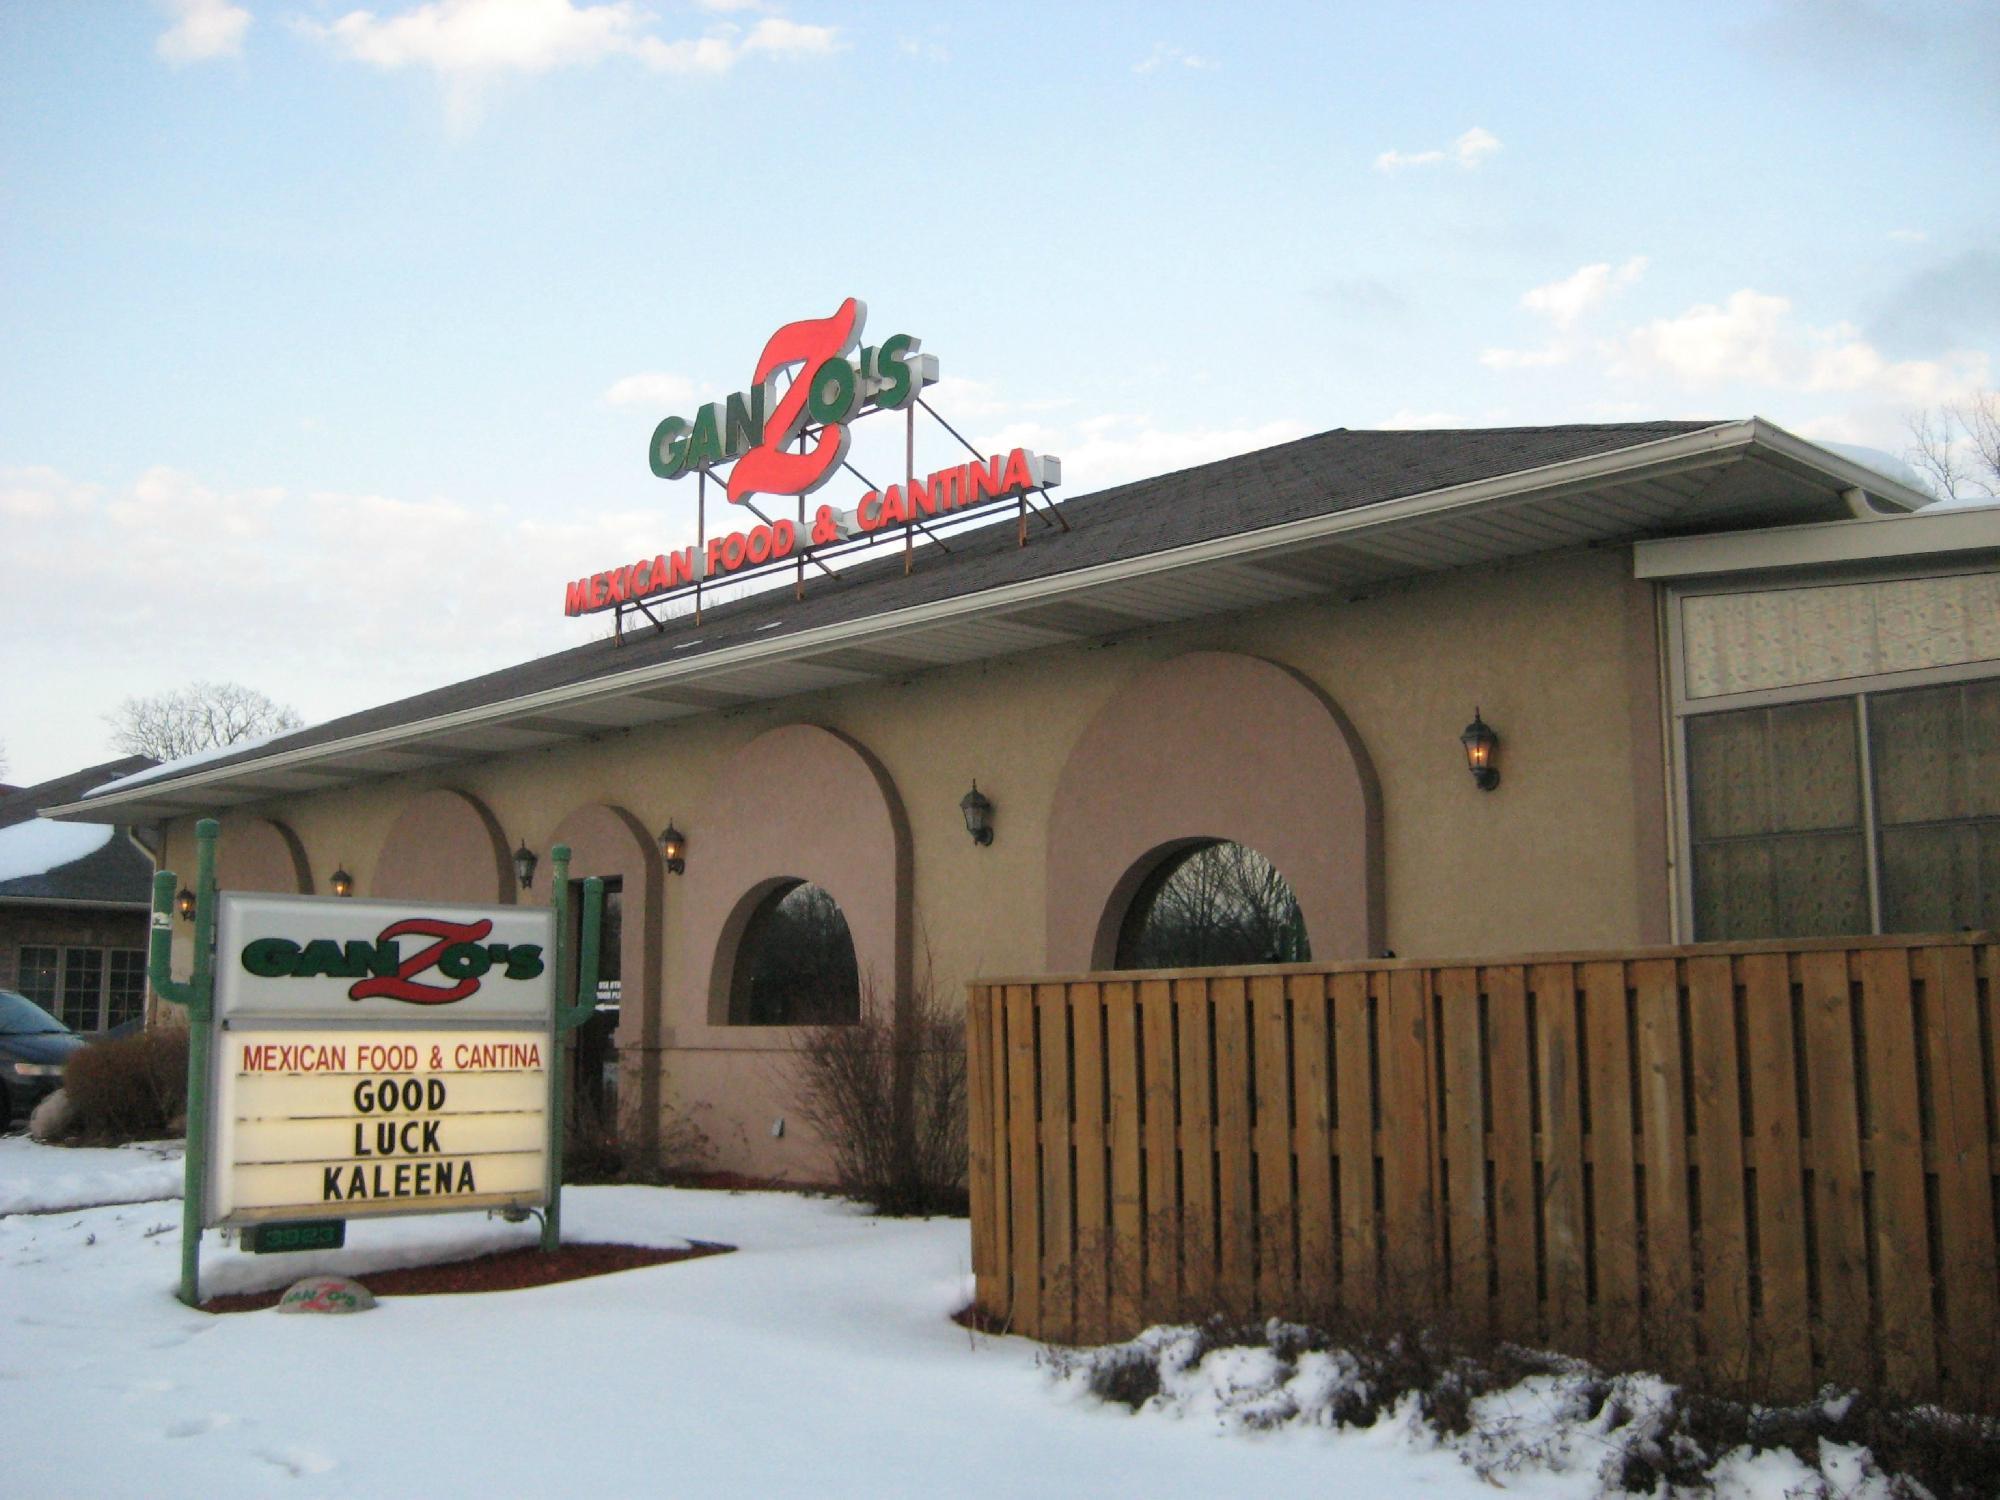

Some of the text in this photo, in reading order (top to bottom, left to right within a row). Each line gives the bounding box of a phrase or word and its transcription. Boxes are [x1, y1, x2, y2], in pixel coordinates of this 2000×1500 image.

[648, 297, 922, 505] GANZO'S
[565, 448, 1034, 618] MEXICAN FOOD & CANTINA
[241, 918, 545, 1005] GANZO'S
[243, 1043, 540, 1071] MEXICAN FOOD & CANTINA
[354, 1079, 446, 1113] GOOD
[354, 1120, 442, 1156] LUCK
[323, 1161, 476, 1201] KALEENA
